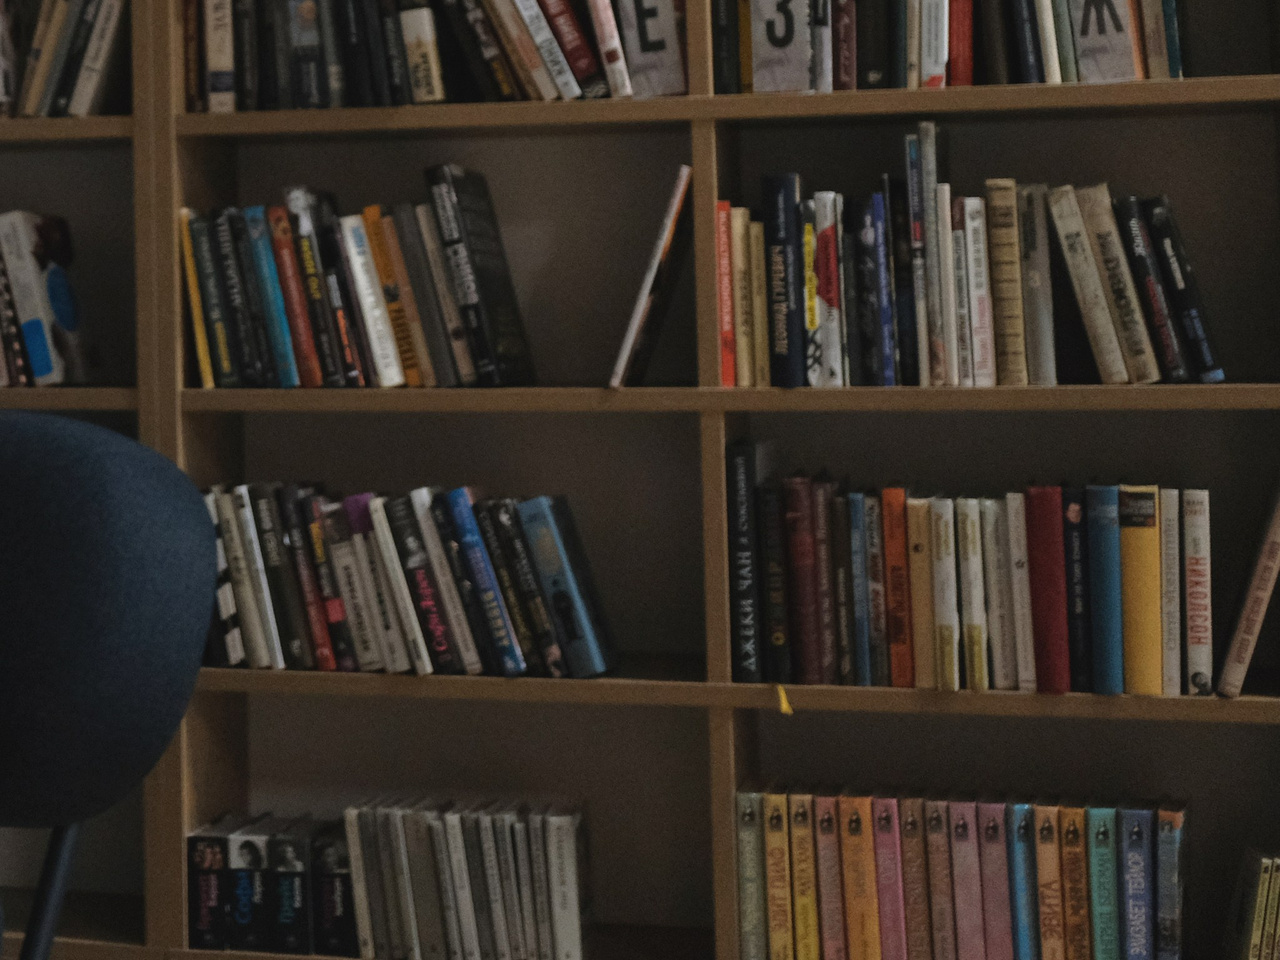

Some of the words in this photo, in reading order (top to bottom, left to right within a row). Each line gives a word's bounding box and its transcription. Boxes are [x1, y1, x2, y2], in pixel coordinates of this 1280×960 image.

[736, 550, 754, 591] ЧАН
[1187, 556, 1210, 646] НИКОЛСОН
[738, 598, 757, 672] ДЖЕКИ
[1125, 852, 1144, 895] ТЕЙЛОР
[1040, 879, 1062, 941] ЭВИТА
[1129, 900, 1147, 956] ЭЛИЗАБЕТ
